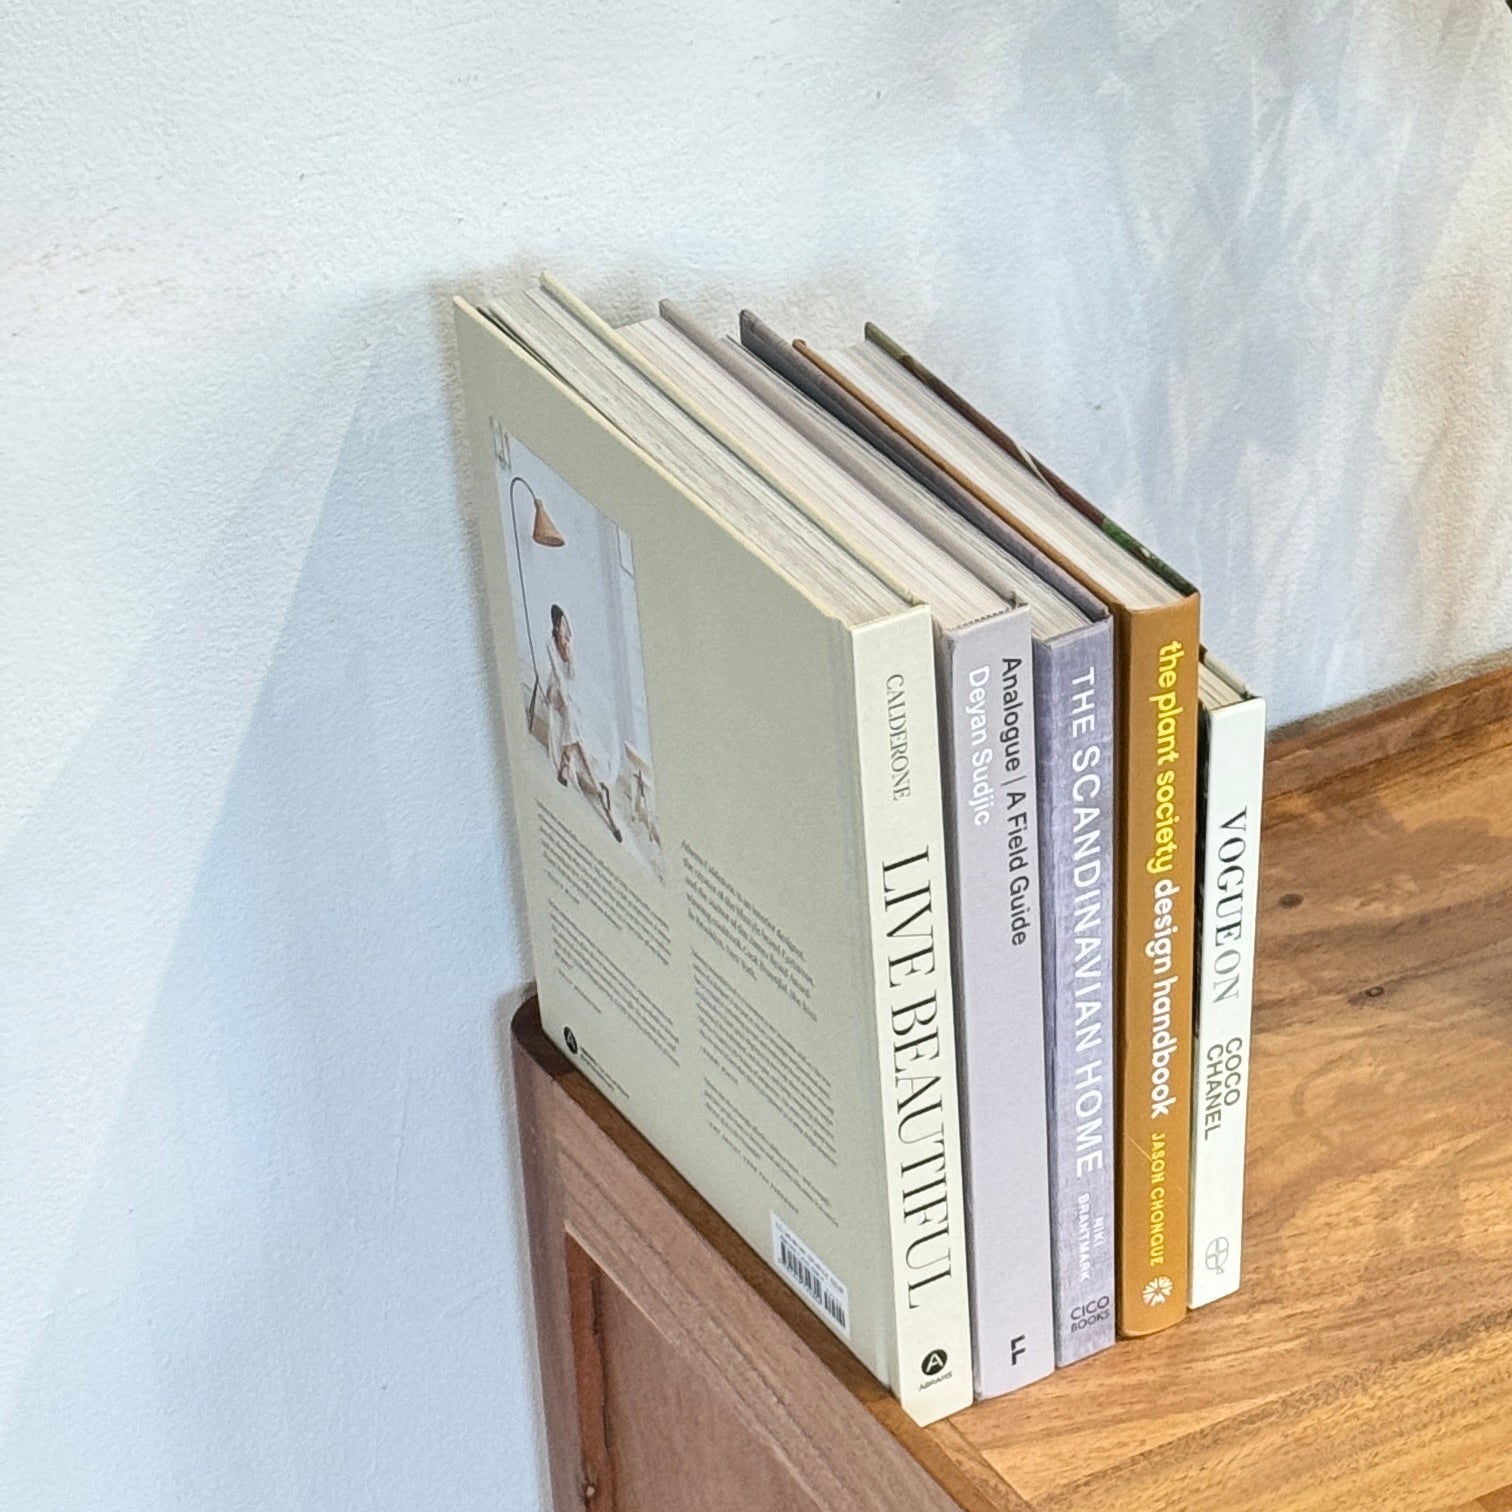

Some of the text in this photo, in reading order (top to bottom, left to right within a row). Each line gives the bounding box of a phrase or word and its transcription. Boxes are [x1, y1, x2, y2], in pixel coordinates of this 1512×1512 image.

[886, 674, 911, 801] CALDERONE
[965, 665, 994, 826] Deyan Sudjic
[1000, 657, 1024, 772] Analogue
[1007, 791, 1026, 810] A
[1007, 812, 1028, 873] Field
[1009, 875, 1031, 946] Guide
[1072, 666, 1104, 1177] THE SCANDINAVIAN HOME
[1145, 640, 1184, 1120] the plant society design handbook
[1212, 806, 1247, 1004] VOGUE ON
[882, 845, 953, 1309] LIVE BEAUTIFUL
[1204, 1043, 1224, 1141] CHANEL
[1223, 1037, 1243, 1107] COCO
[1151, 1132, 1166, 1185] JASON
[1077, 1192, 1091, 1283] BRANTMARK
[1092, 1216, 1104, 1247] NIKI
[1070, 1296, 1110, 1320] CICO
[1071, 1308, 1111, 1333] BOOKS
